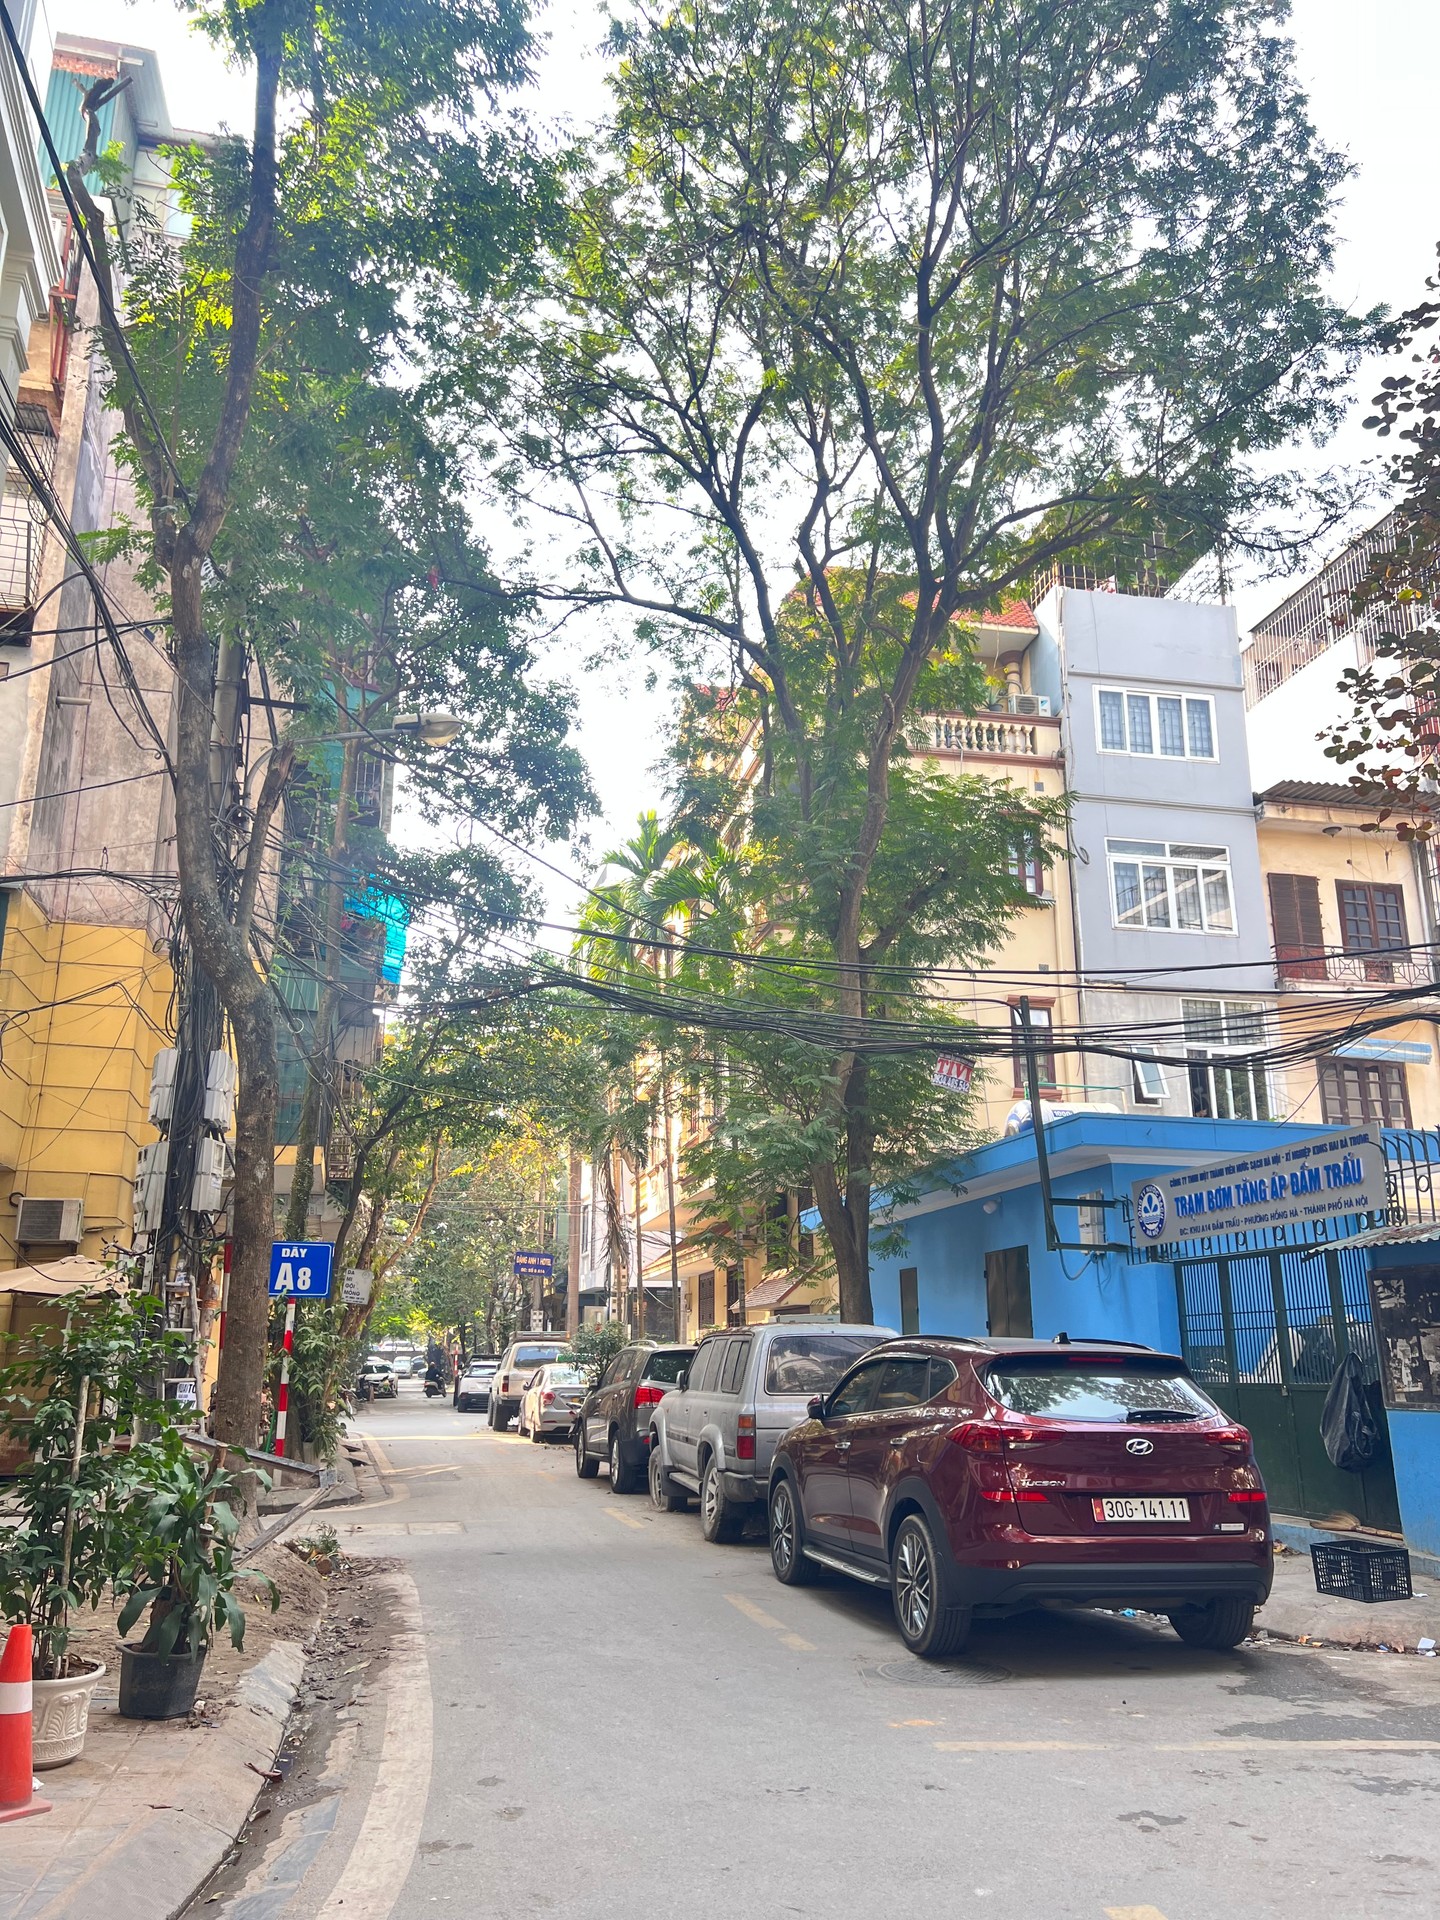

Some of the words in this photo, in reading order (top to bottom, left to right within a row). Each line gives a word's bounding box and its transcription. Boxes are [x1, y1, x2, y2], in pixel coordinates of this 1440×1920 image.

[937, 1058, 973, 1083] TIVI
[1182, 1176, 1188, 1185] TY
[1250, 1158, 1263, 1171] SẠCH
[1340, 1136, 1348, 1149] BÀ
[1174, 1191, 1207, 1221] TRẠM
[1207, 1185, 1235, 1212] BƠM
[1235, 1177, 1269, 1206] TĂNG
[1270, 1172, 1288, 1200] ÁP
[1290, 1161, 1324, 1196] ĐẦM
[1323, 1151, 1364, 1189] TRẤU
[1189, 1223, 1201, 1234] KHU
[1201, 1223, 1211, 1233] A14
[1244, 1212, 1269, 1225] PHƯỜNG
[1289, 1206, 1298, 1218] HÀ
[1303, 1203, 1326, 1215] THÀNH
[1328, 1197, 1342, 1211] PHỐ
[1344, 1196, 1354, 1208] HÀ
[1355, 1194, 1369, 1208] NỘI
[281, 1246, 308, 1258] DÃY
[274, 1262, 312, 1290] A8
[1020, 1478, 1066, 1487] TUCSON
[1105, 1500, 1186, 1518] 30G-141.11
